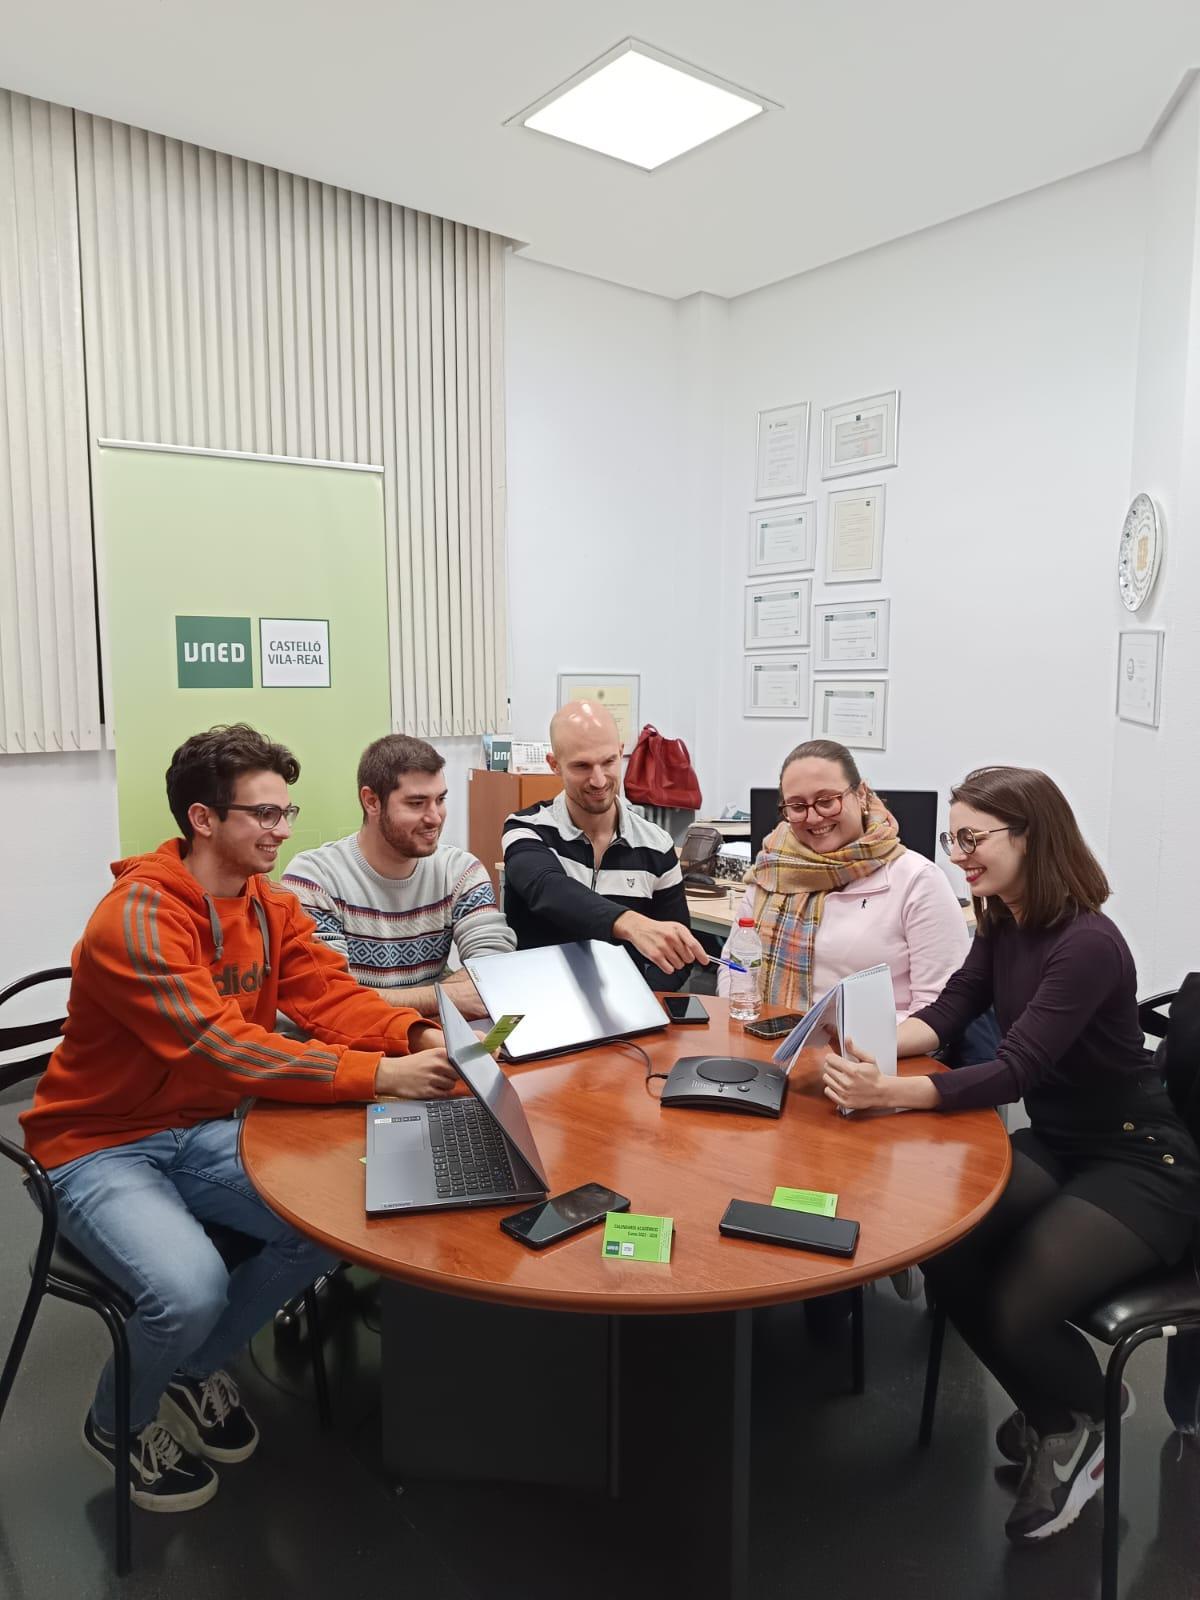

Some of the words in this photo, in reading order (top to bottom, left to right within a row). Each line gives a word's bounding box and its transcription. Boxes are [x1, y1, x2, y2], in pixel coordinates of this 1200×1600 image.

[269, 640, 322, 652] CASTELLÓ
[184, 642, 245, 663] UNED
[268, 654, 324, 665] VILA-REAL
